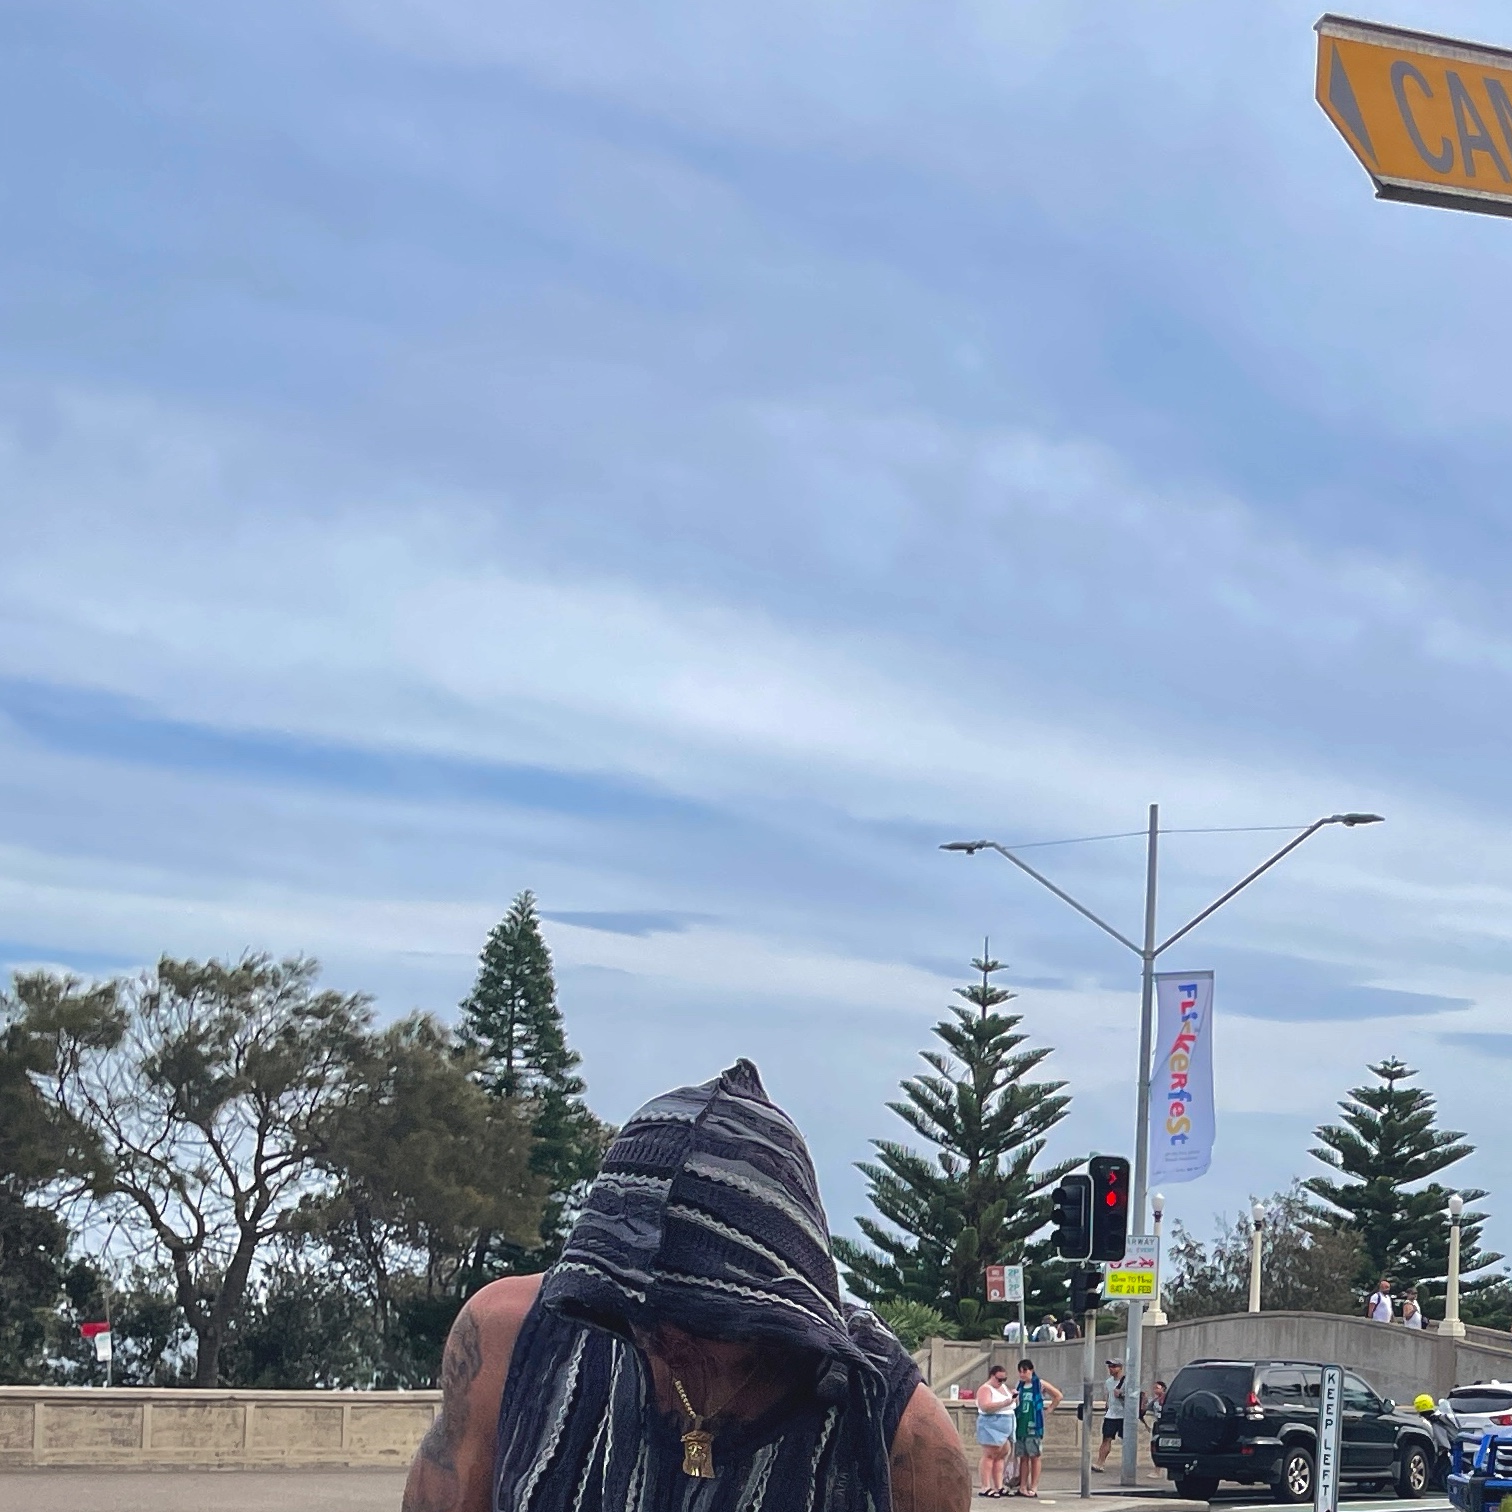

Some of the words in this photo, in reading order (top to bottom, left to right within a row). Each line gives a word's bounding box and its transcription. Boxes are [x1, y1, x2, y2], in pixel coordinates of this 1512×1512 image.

[1109, 1284, 1123, 1293] SAT
[1126, 1284, 1135, 1294] 24
[1138, 1285, 1151, 1294] FEB
[1325, 1373, 1335, 1430] KEEP
[1322, 1438, 1331, 1497] LEFT
